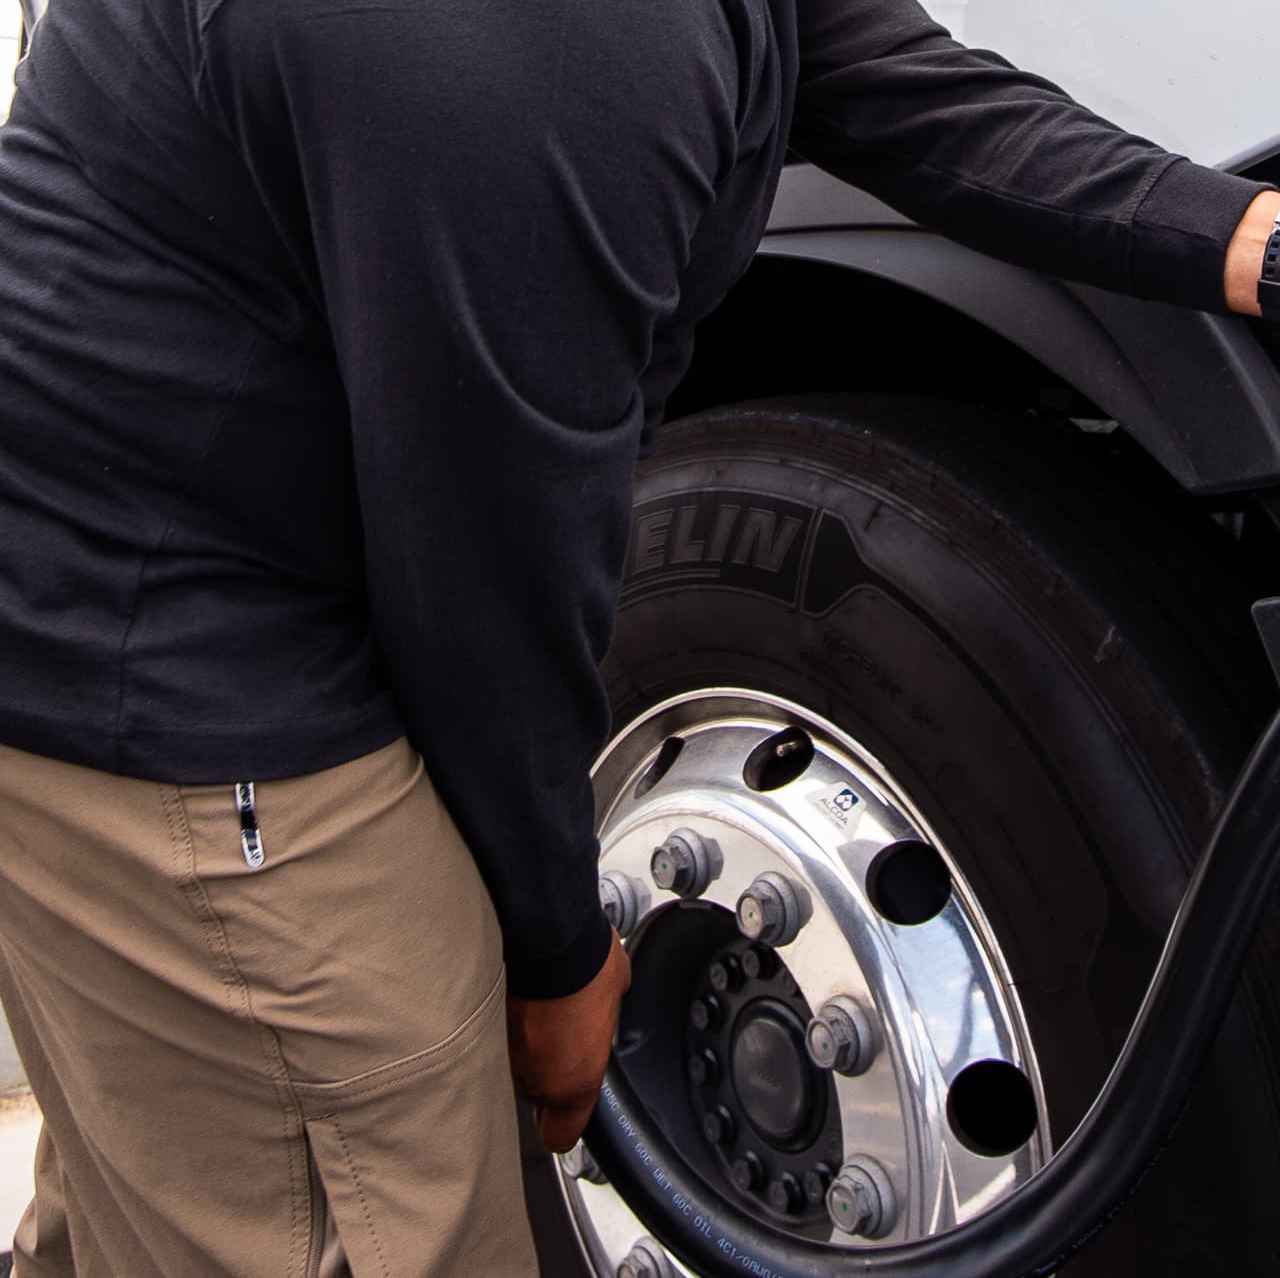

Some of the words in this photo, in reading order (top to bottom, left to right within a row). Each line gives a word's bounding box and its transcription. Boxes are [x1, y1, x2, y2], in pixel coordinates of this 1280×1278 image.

[819, 798, 848, 824] ALCOA
[617, 1114, 636, 1139] DRY
[672, 1193, 693, 1216] 60C
[693, 1215, 713, 1239] OIL
